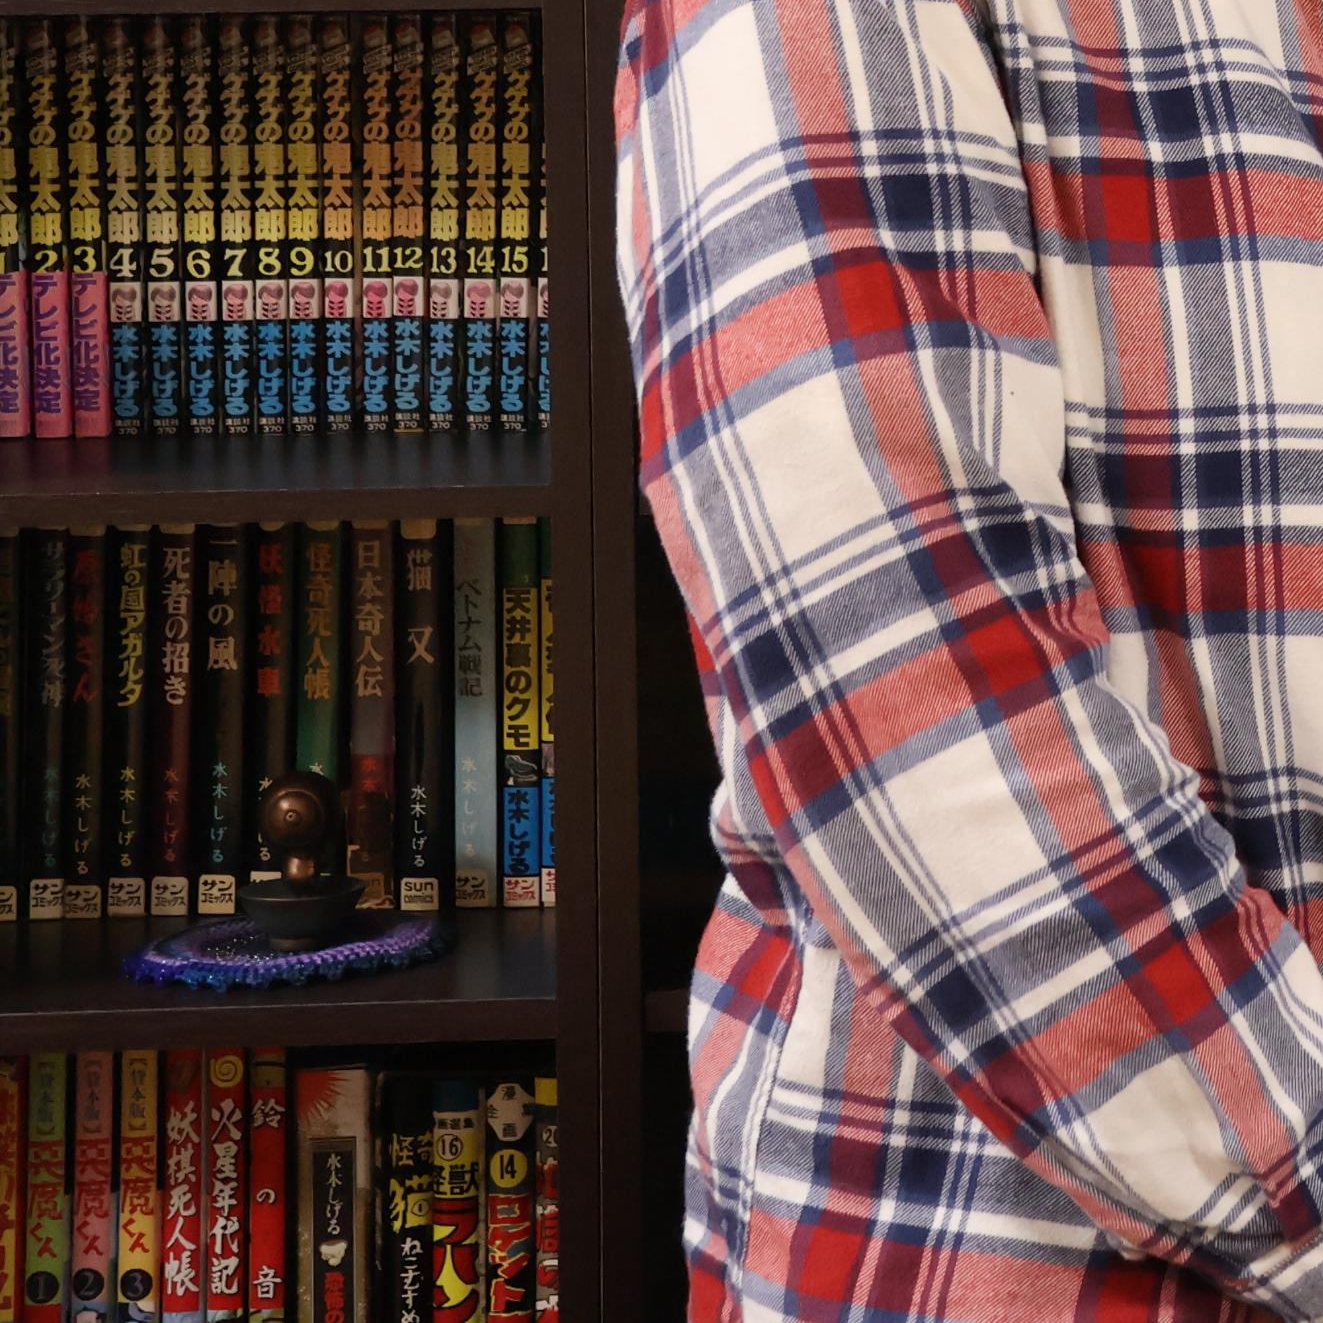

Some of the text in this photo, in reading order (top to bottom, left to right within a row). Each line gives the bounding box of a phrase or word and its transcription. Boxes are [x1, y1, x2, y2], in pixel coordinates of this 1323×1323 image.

[110, 248, 137, 277] 4
[187, 249, 210, 278] 6
[224, 248, 247, 277] 7
[258, 247, 281, 275] 8
[325, 250, 353, 273] 10
[394, 246, 423, 269] 12
[467, 246, 495, 273] 14
[501, 246, 528, 273] 15
[326, 321, 351, 413] 水木しげる
[395, 319, 420, 410] 水木しげる
[162, 548, 191, 705] 死者の招き
[210, 762, 228, 863] 水木しげる
[508, 789, 530, 874] 水木しげる
[499, 1155, 516, 1180] 14
[326, 1153, 343, 1235] 水木しげる
